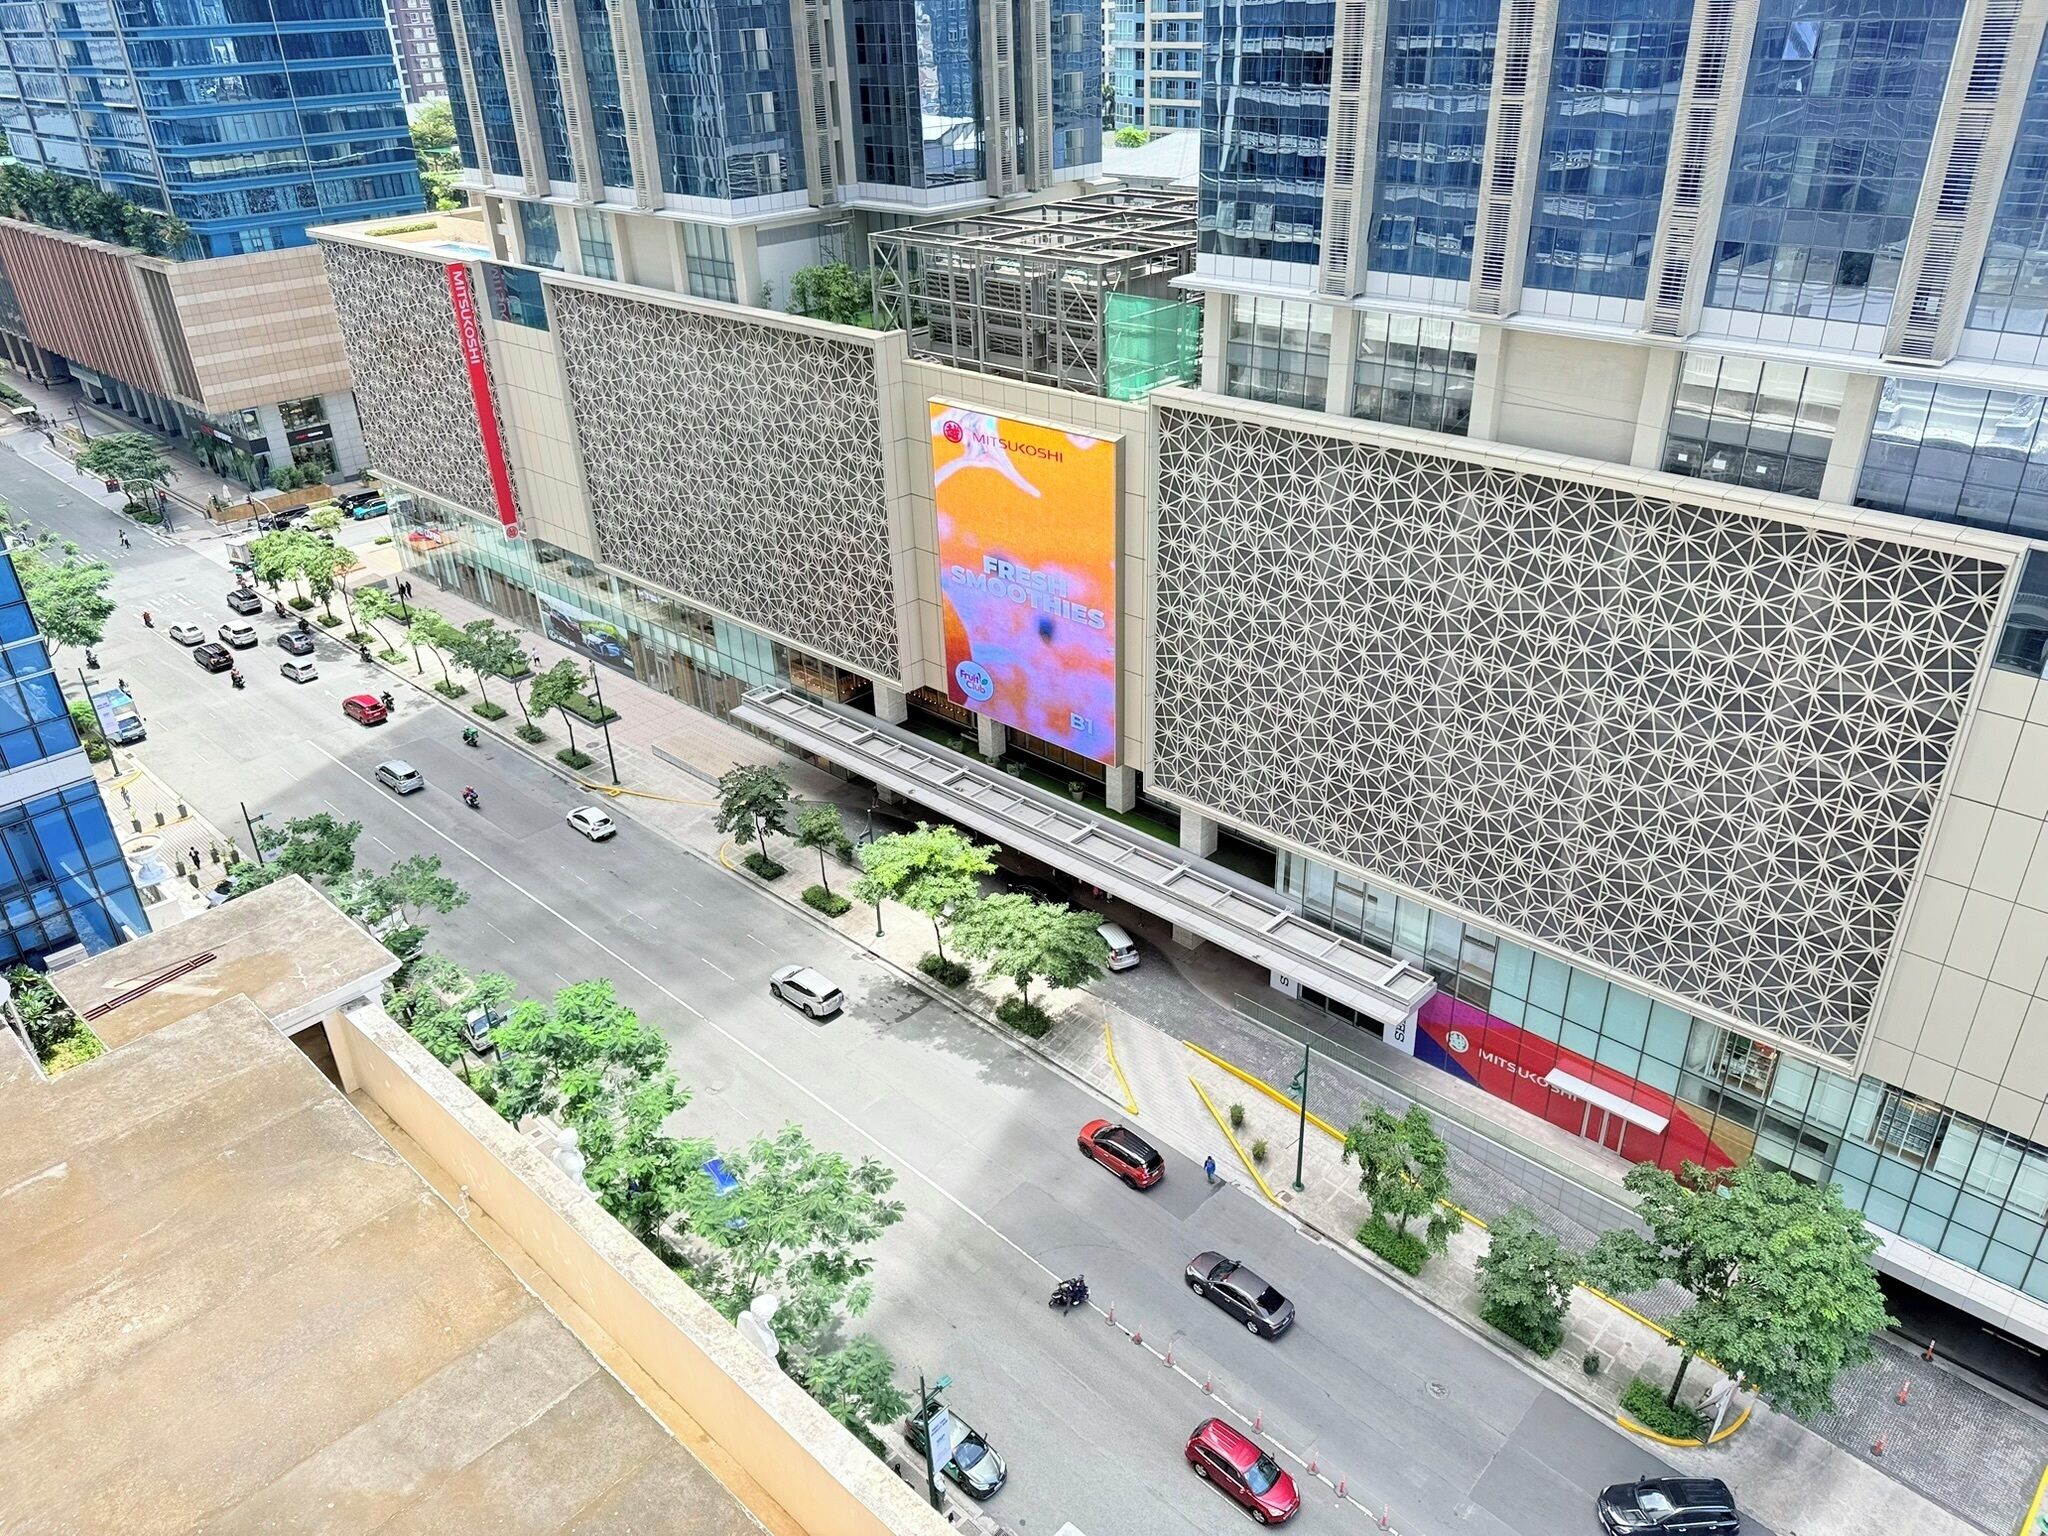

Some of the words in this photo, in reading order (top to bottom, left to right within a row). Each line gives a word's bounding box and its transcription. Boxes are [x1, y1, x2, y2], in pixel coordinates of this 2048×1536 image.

[452, 270, 481, 365] MITSUKOSHI
[972, 432, 1064, 463] MITSUKOSHI
[983, 554, 1068, 598] FRESH
[951, 564, 1106, 630] SMOOTHIES
[960, 669, 980, 684] Fruit
[966, 680, 986, 694] Club
[1071, 712, 1093, 736] B1
